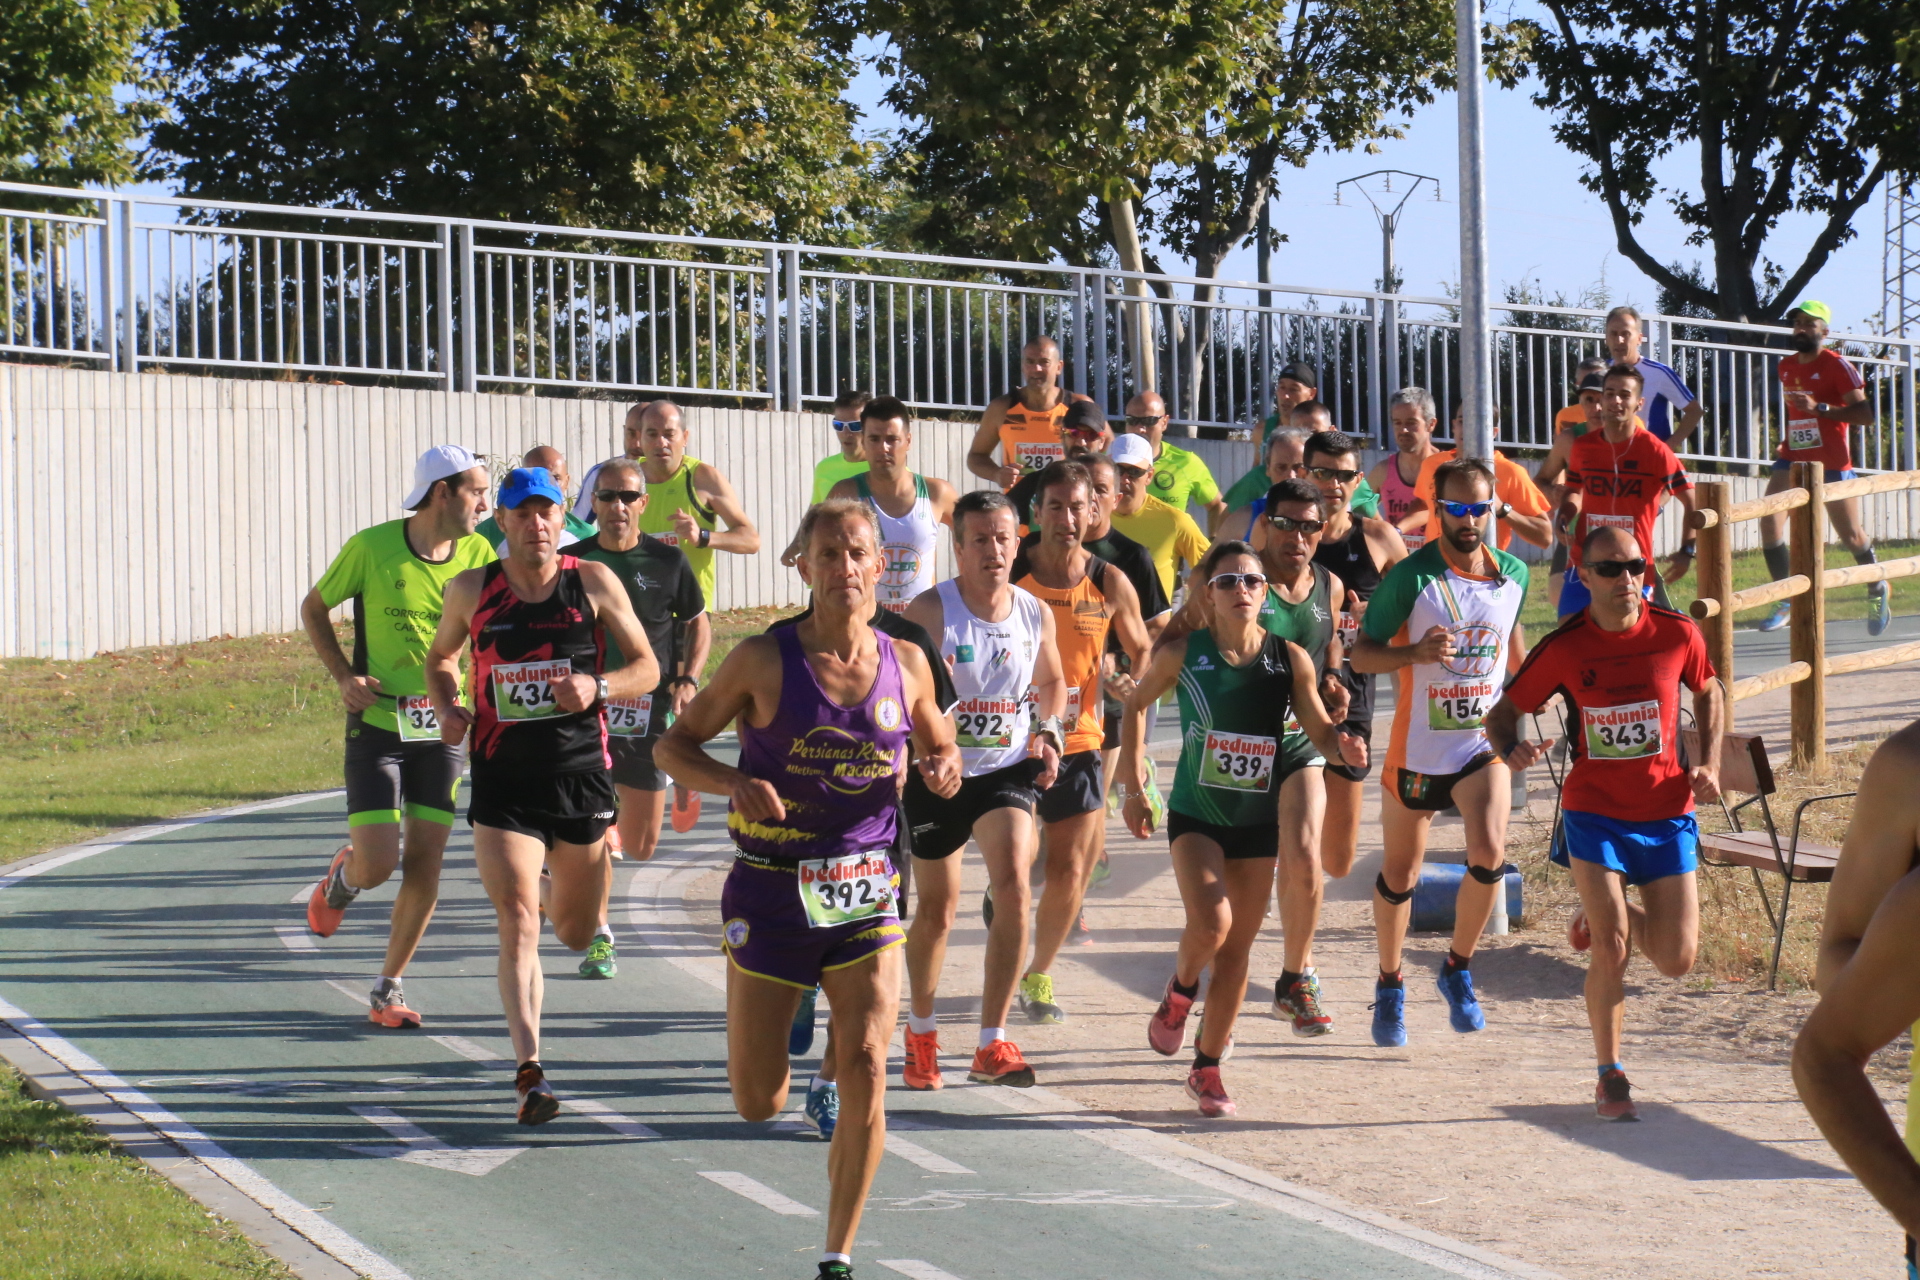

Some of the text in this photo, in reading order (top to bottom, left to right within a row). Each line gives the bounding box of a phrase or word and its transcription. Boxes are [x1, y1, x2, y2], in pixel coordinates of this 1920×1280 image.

[1793, 430, 1813, 442] 285
[1016, 445, 1063, 456] bedunia
[1584, 475, 1642, 498] KENYA
[885, 561, 917, 573] LCER
[384, 606, 442, 622] CORRECAM
[493, 664, 570, 685] bedunia
[1428, 682, 1492, 699] bedunia
[606, 706, 637, 727] 75
[955, 698, 1017, 714] edunia
[1442, 698, 1483, 719] 154
[1585, 706, 1659, 726] bedunia
[958, 714, 1003, 736] 292
[1600, 723, 1647, 747] 343
[789, 738, 855, 759] Persianas
[1206, 734, 1277, 757] bedunia
[1216, 752, 1262, 778] 339
[742, 851, 771, 865] Kalenji
[801, 857, 886, 885] bedunia
[818, 878, 876, 911] 392
